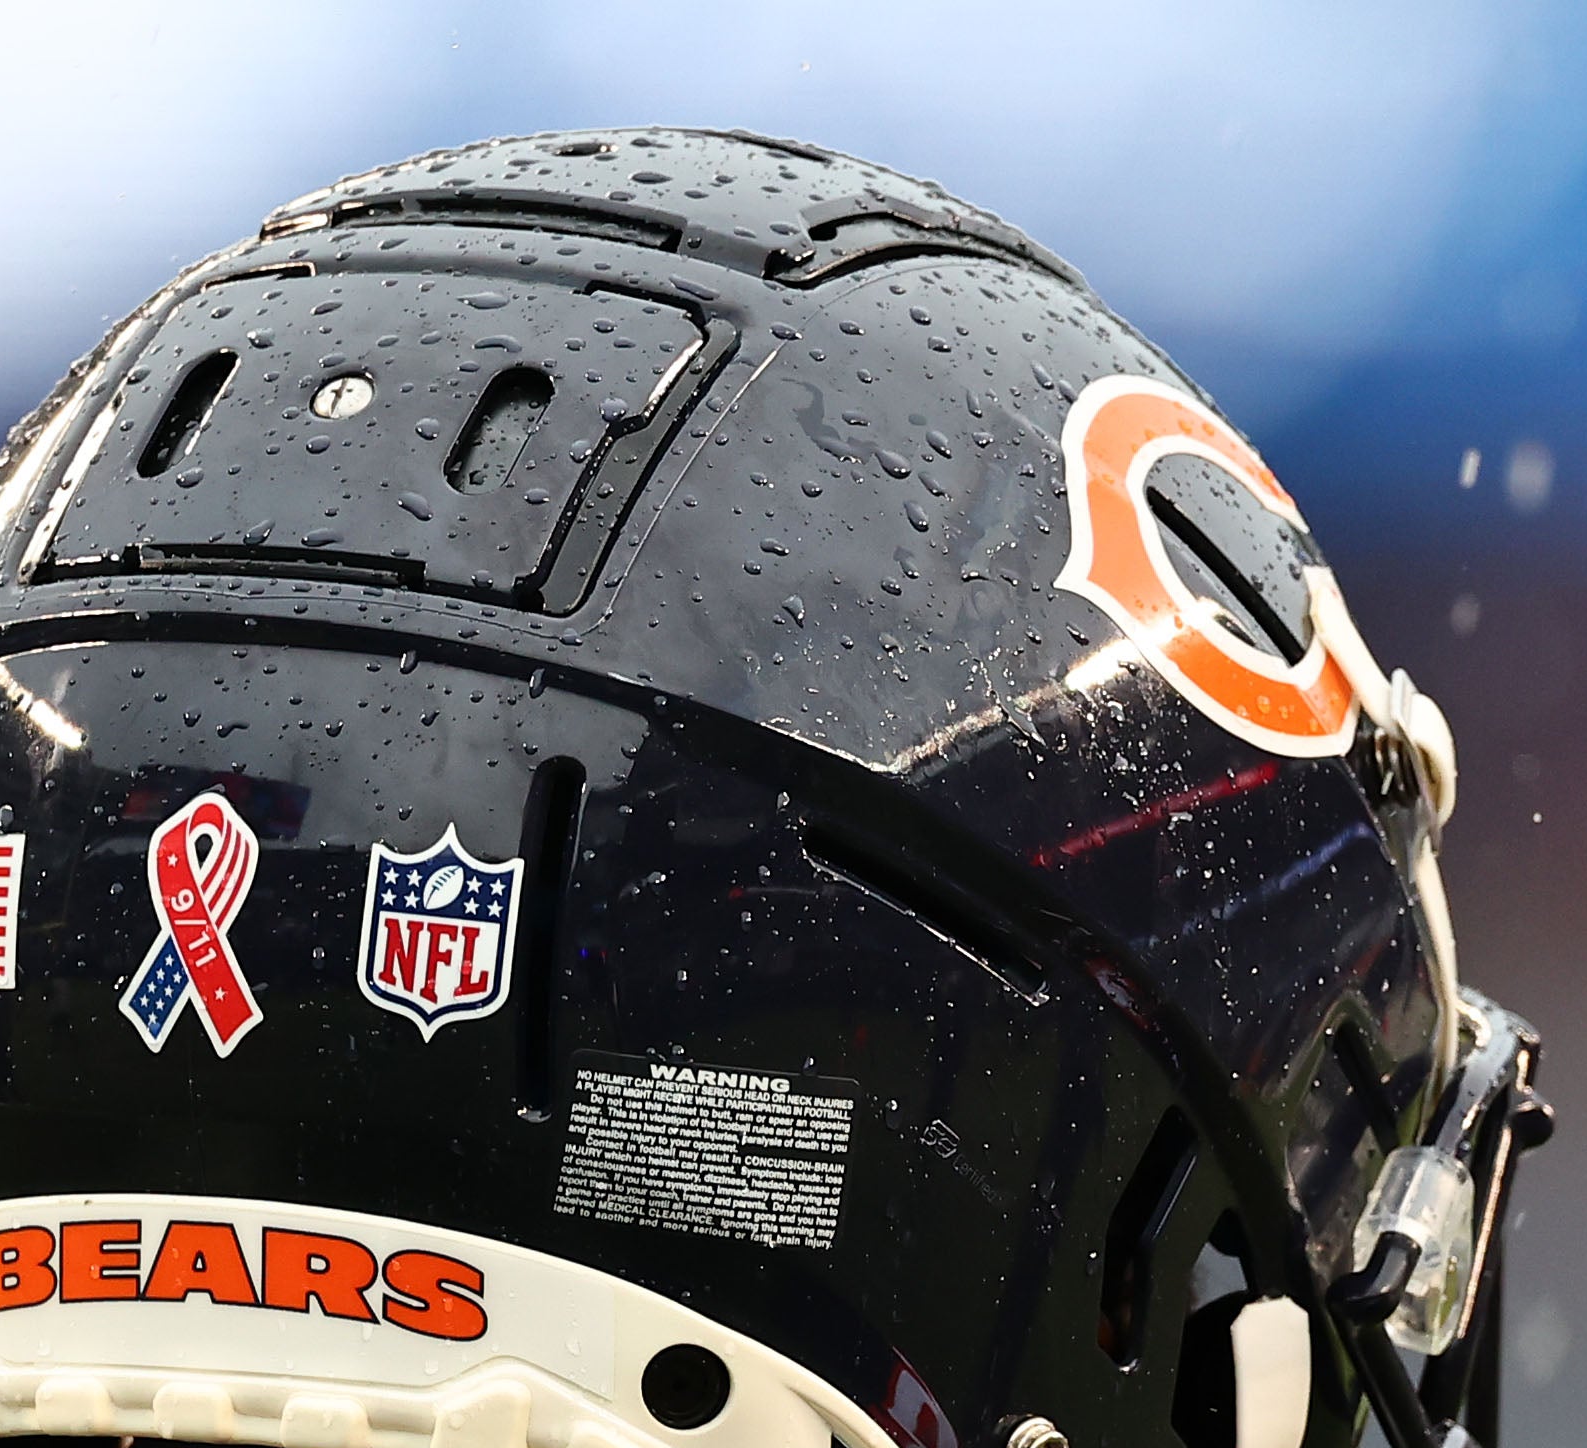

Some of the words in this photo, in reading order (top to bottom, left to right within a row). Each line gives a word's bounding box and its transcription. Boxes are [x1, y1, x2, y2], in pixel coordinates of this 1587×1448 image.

[171, 888, 217, 968] 9/11
[381, 918, 490, 1004] NFL
[577, 1070, 592, 1080] NO
[594, 1073, 633, 1086] HELMET
[634, 1078, 654, 1088] CAN
[656, 1081, 699, 1094] PREVENT
[702, 1086, 742, 1099] SERIOUS
[744, 1091, 770, 1101] HEAD
[772, 1093, 786, 1103] OR
[787, 1095, 812, 1106] NECK
[814, 1098, 853, 1109] INJURIES
[650, 1064, 790, 1092] WARNING
[576, 1081, 582, 1089] A
[585, 1082, 621, 1095] PLAYER
[623, 1088, 652, 1099] MIGHT
[653, 1091, 693, 1104] RECEIVE
[695, 1096, 724, 1108] WHILE
[726, 1100, 791, 1114] PARTICIPATING
[793, 1106, 802, 1116] IN
[804, 1107, 851, 1120] FOOTBALL.
[591, 1094, 604, 1104] Do
[607, 1098, 623, 1107] not
[626, 1100, 642, 1109] use
[645, 1101, 662, 1111] this
[665, 1104, 697, 1115] helmet
[700, 1108, 709, 1117] to
[712, 1109, 732, 1120] butt,
[736, 1113, 753, 1121] ram
[756, 1115, 766, 1123] or
[769, 1116, 794, 1125] spear
[796, 1119, 807, 1127] an
[810, 1120, 850, 1133] opposing
[569, 1125, 586, 1134] and
[588, 1128, 628, 1140] possible
[630, 1132, 656, 1144] injury
[658, 1136, 668, 1145] to
[670, 1139, 691, 1147] your
[693, 1141, 737, 1152] opponent.
[570, 1114, 597, 1124] result
[599, 1117, 608, 1126] in
[611, 1120, 641, 1131] severe
[643, 1123, 666, 1134] head
[668, 1127, 679, 1135] or
[680, 1129, 702, 1137] neck
[704, 1130, 739, 1143] injuries,
[795, 1140, 819, 1149] death
[821, 1142, 830, 1151] to
[832, 1144, 847, 1153] you
[572, 1103, 602, 1114] player.
[608, 1107, 627, 1118] This
[629, 1110, 637, 1119] is
[639, 1111, 647, 1121] in
[650, 1113, 688, 1125] violation
[701, 1119, 715, 1129] the
[717, 1120, 750, 1133] football
[752, 1125, 774, 1135] rules
[776, 1128, 793, 1137] and
[794, 1130, 815, 1138] such
[817, 1132, 832, 1140] use
[834, 1133, 849, 1141] can
[565, 1144, 602, 1157] INJURY
[604, 1151, 632, 1161] which
[634, 1156, 646, 1164] no
[648, 1156, 679, 1167] helmet
[681, 1161, 698, 1170] can
[700, 1164, 735, 1174] prevent.
[789, 1171, 823, 1182] include:
[825, 1174, 842, 1184] loss
[586, 1136, 623, 1150] Contact
[627, 1142, 636, 1152] in
[640, 1144, 676, 1157] football
[679, 1150, 699, 1161] may
[702, 1153, 729, 1163] result
[732, 1154, 741, 1164] in
[745, 1156, 844, 1173] CONCUSSION-BRAIN
[560, 1176, 587, 1186] report
[615, 1184, 624, 1192] to
[627, 1187, 647, 1195] your
[650, 1190, 679, 1201] coach,
[683, 1192, 712, 1203] trainer
[714, 1198, 731, 1206] and
[733, 1200, 767, 1210] parents.
[773, 1202, 785, 1212] Do
[786, 1205, 801, 1213] not
[802, 1206, 828, 1215] return
[829, 1207, 838, 1216] to
[561, 1166, 607, 1179] confusion.
[614, 1173, 621, 1181] If
[623, 1176, 639, 1184] you
[642, 1177, 664, 1187] have
[666, 1181, 714, 1194] symptoms,
[771, 1192, 790, 1203] stop
[791, 1194, 822, 1205] playing
[824, 1197, 840, 1205] and
[576, 1159, 646, 1174] consciousness
[649, 1168, 659, 1176] or
[662, 1170, 701, 1182] memory,
[704, 1174, 748, 1187] dizziness,
[752, 1179, 796, 1192] headache,
[799, 1185, 830, 1194] nausea
[832, 1187, 841, 1195] or
[554, 1204, 575, 1214] lead
[580, 1208, 590, 1216] to
[595, 1212, 633, 1223] another
[639, 1219, 658, 1227] and
[663, 1222, 688, 1231] more
[693, 1226, 729, 1237] serious
[776, 1235, 800, 1245] brain
[805, 1237, 832, 1249] injury.
[556, 1196, 595, 1207] received
[599, 1201, 644, 1215] MEDICAL
[649, 1209, 713, 1224] CLEARANCE.
[721, 1219, 759, 1231] Ignoring
[761, 1223, 778, 1233] this
[781, 1226, 814, 1237] warning
[817, 1229, 835, 1239] may
[566, 1188, 591, 1196] game
[607, 1194, 645, 1205] practice
[649, 1200, 670, 1208] until
[672, 1202, 684, 1210] all
[687, 1205, 734, 1217] symptoms
[737, 1211, 752, 1219] are
[754, 1213, 776, 1222] gone
[779, 1214, 795, 1223] and
[798, 1217, 814, 1225] you
[816, 1217, 836, 1227] have
